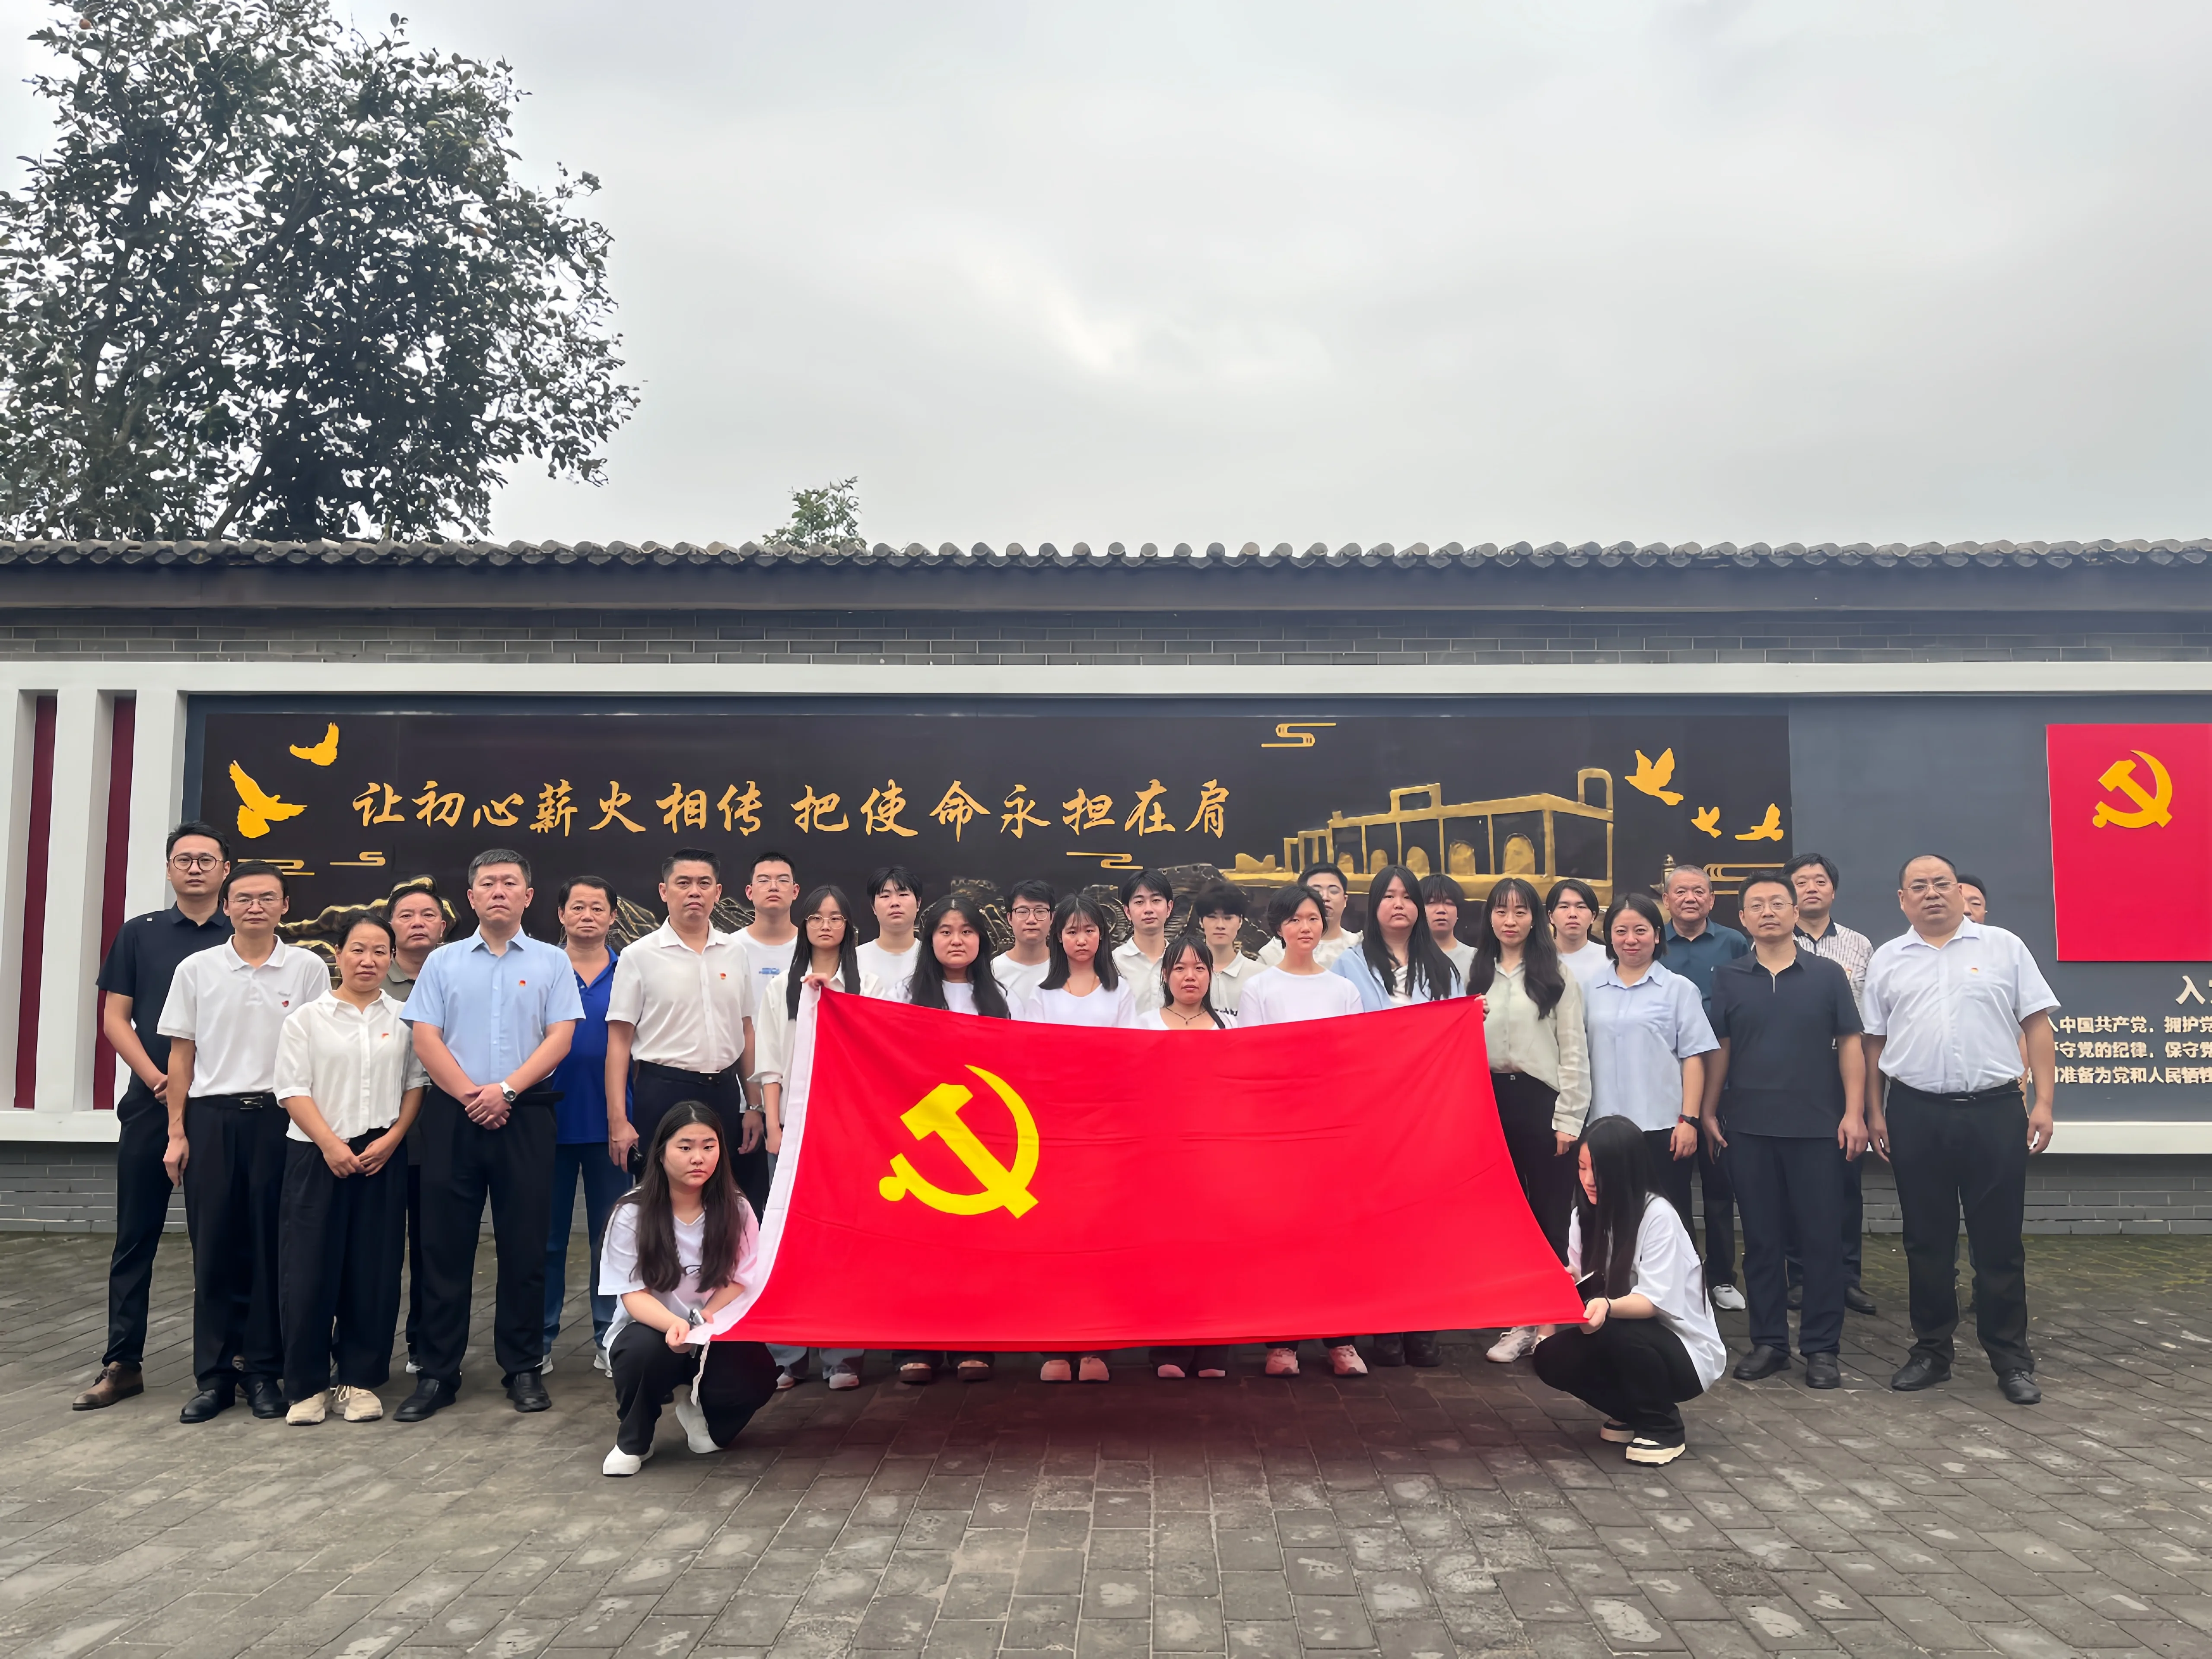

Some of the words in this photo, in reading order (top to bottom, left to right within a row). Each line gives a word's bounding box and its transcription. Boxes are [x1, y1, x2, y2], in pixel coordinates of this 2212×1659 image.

[352, 779, 763, 837] 让初心薪火相传
[791, 779, 1230, 841] 把使命永担在肩
[2175, 975, 2212, 1004] 入
[2054, 1065, 2212, 1084] 准备为党和人民牺牲
